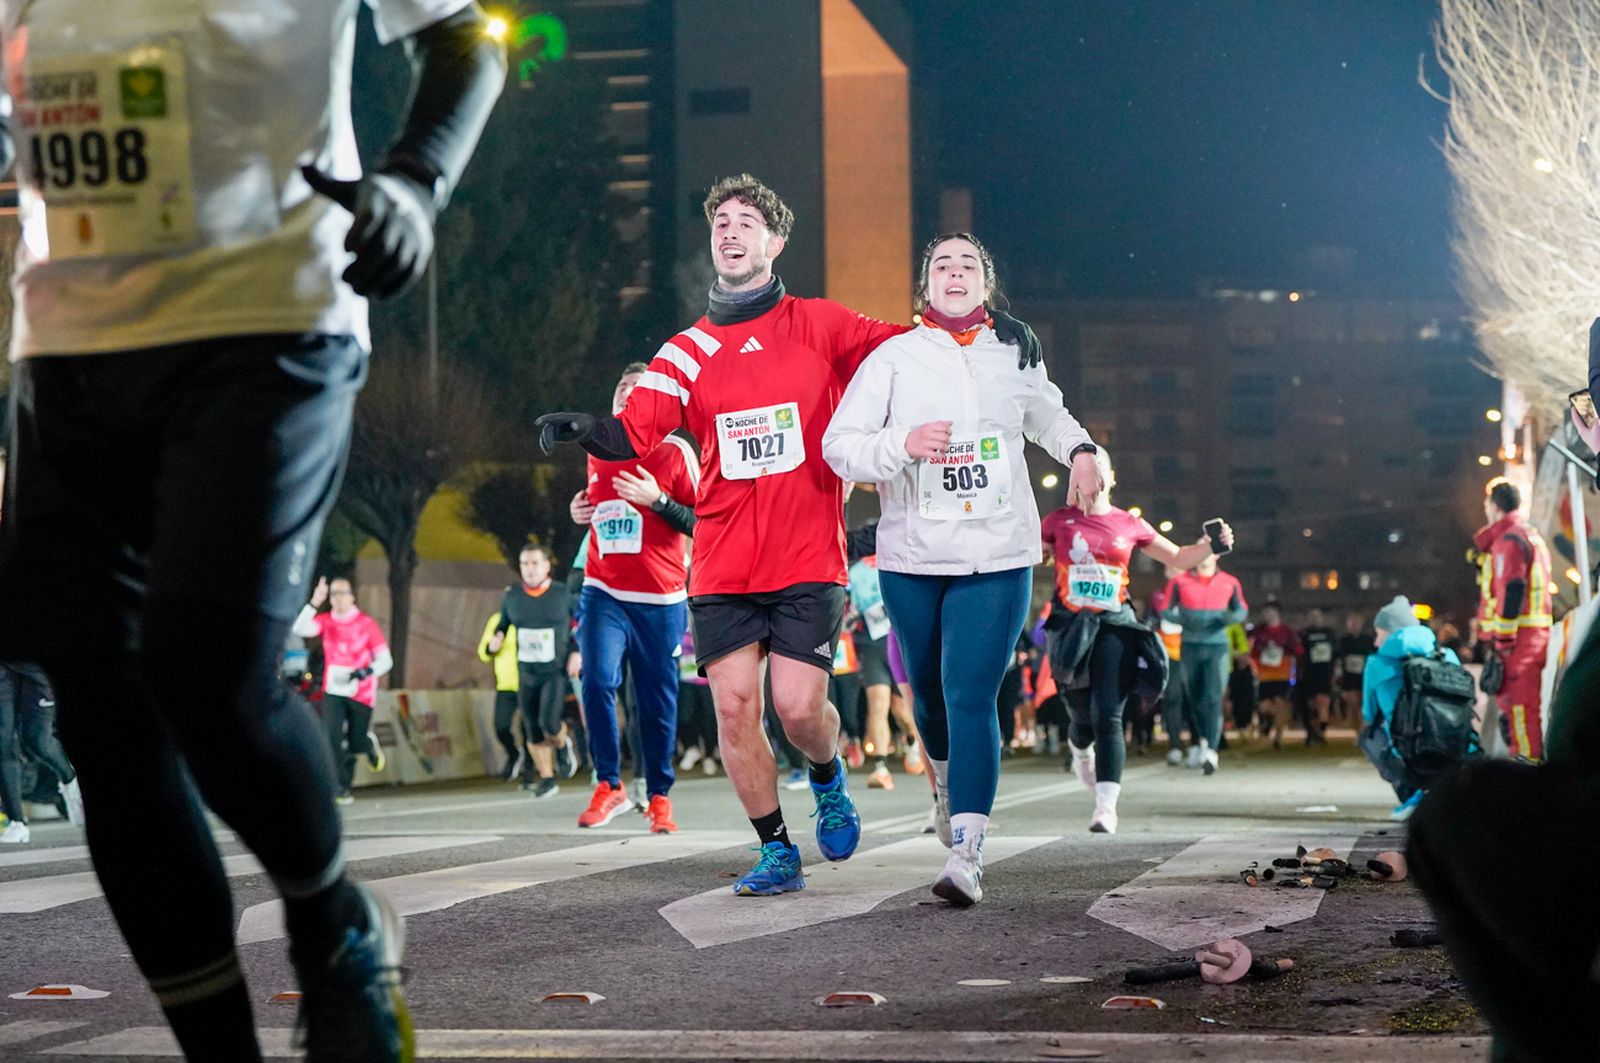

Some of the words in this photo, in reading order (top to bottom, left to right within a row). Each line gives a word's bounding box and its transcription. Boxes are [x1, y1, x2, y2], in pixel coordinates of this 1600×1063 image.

[735, 418, 757, 428] NOCHE
[758, 416, 769, 424] DE
[727, 429, 743, 439] SAN
[737, 432, 785, 462] 7027
[940, 444, 964, 454] OCHE
[965, 443, 975, 453] DE
[943, 463, 989, 492] 503
